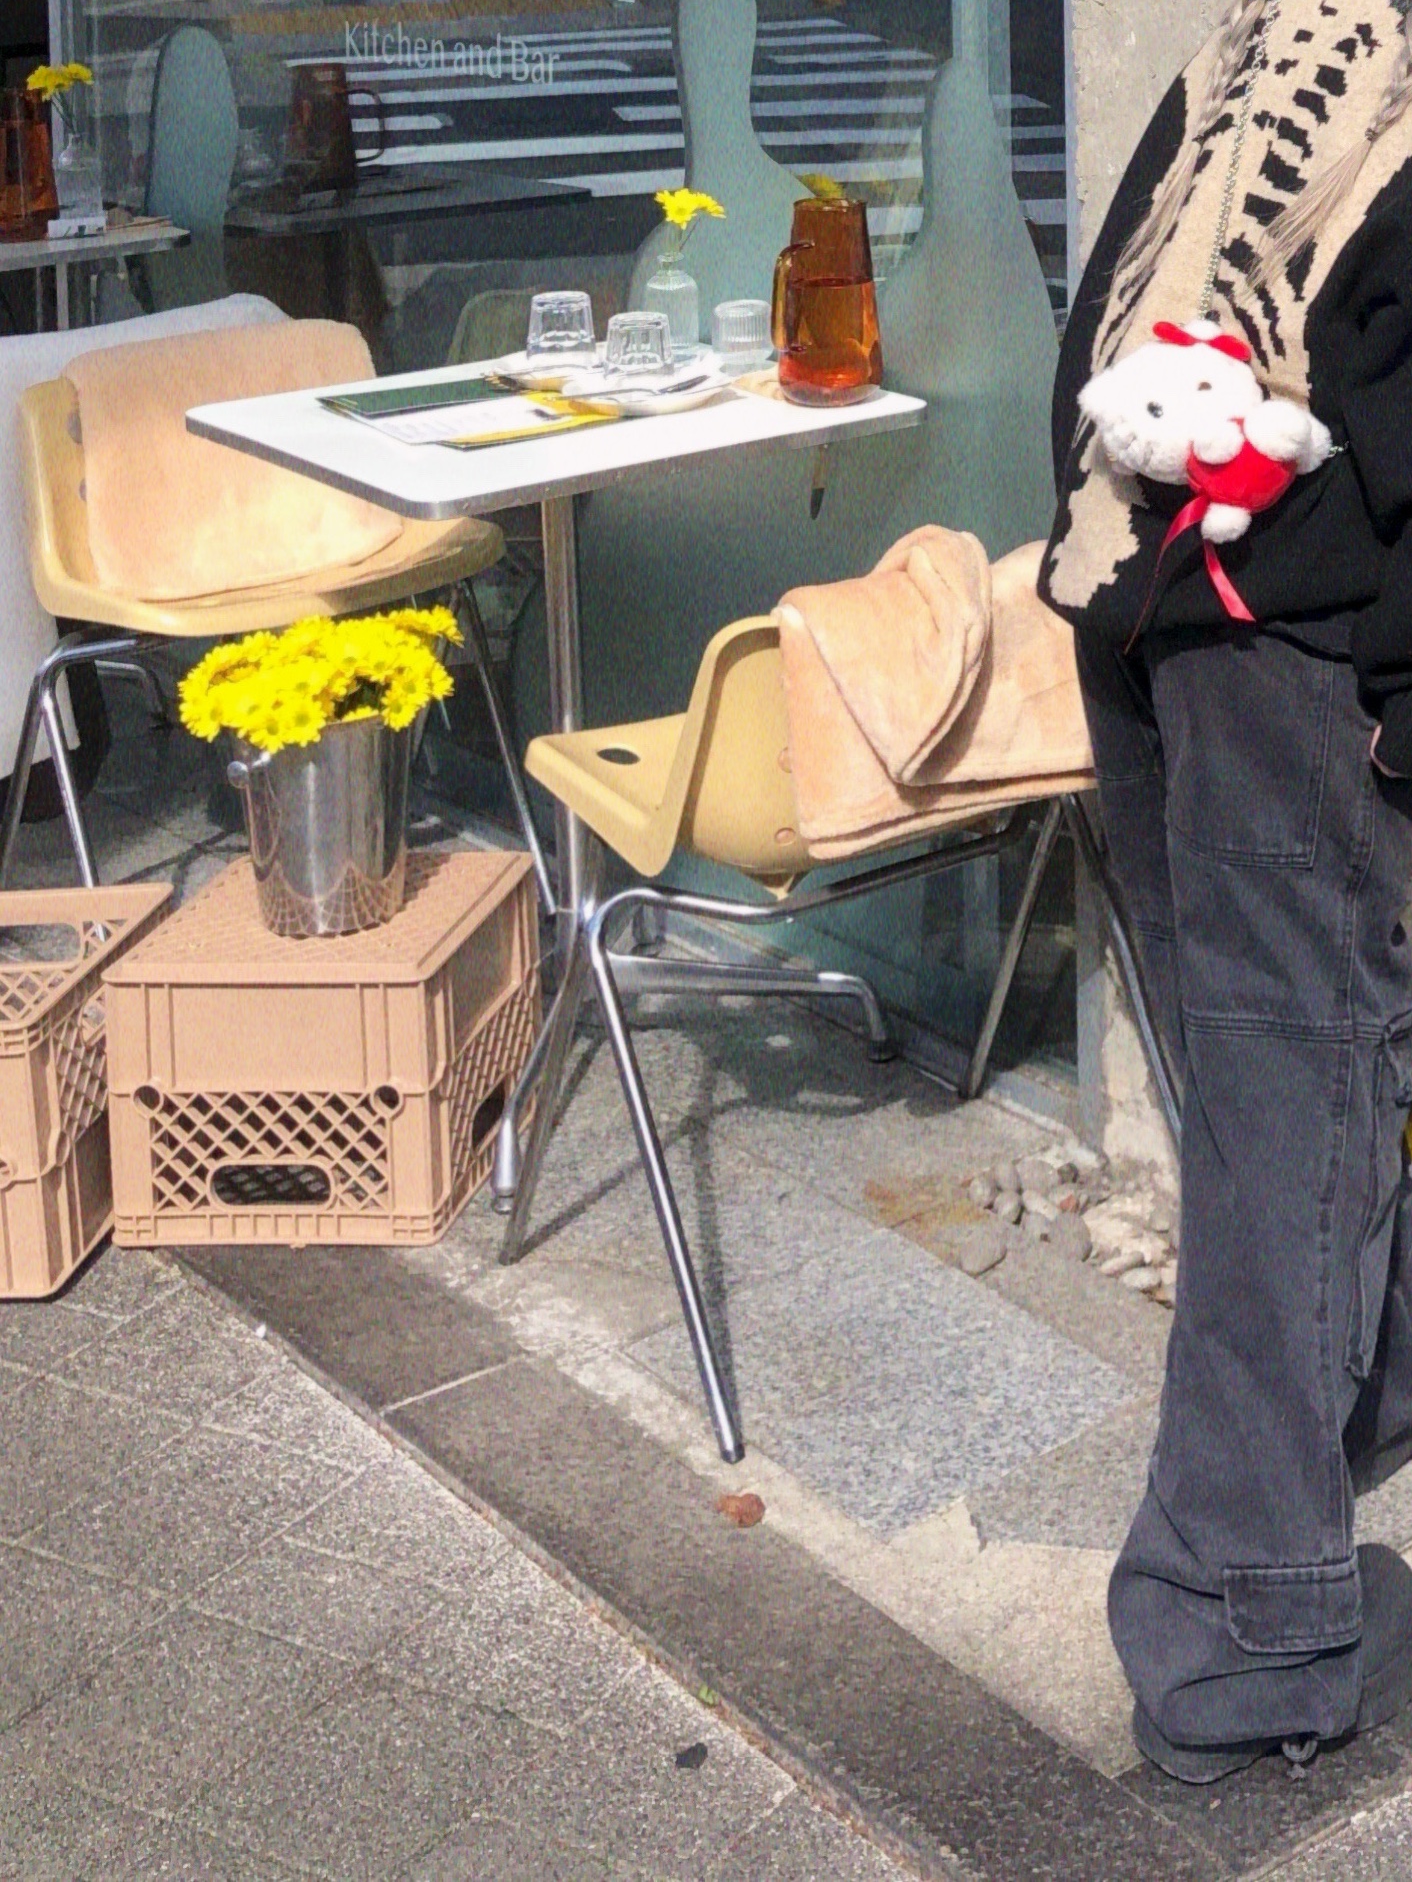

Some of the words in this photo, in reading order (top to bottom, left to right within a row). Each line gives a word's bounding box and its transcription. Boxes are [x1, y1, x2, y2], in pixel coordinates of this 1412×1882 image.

[345, 20, 444, 68] Kitchen
[453, 32, 502, 79] and
[510, 40, 560, 84] Bar
